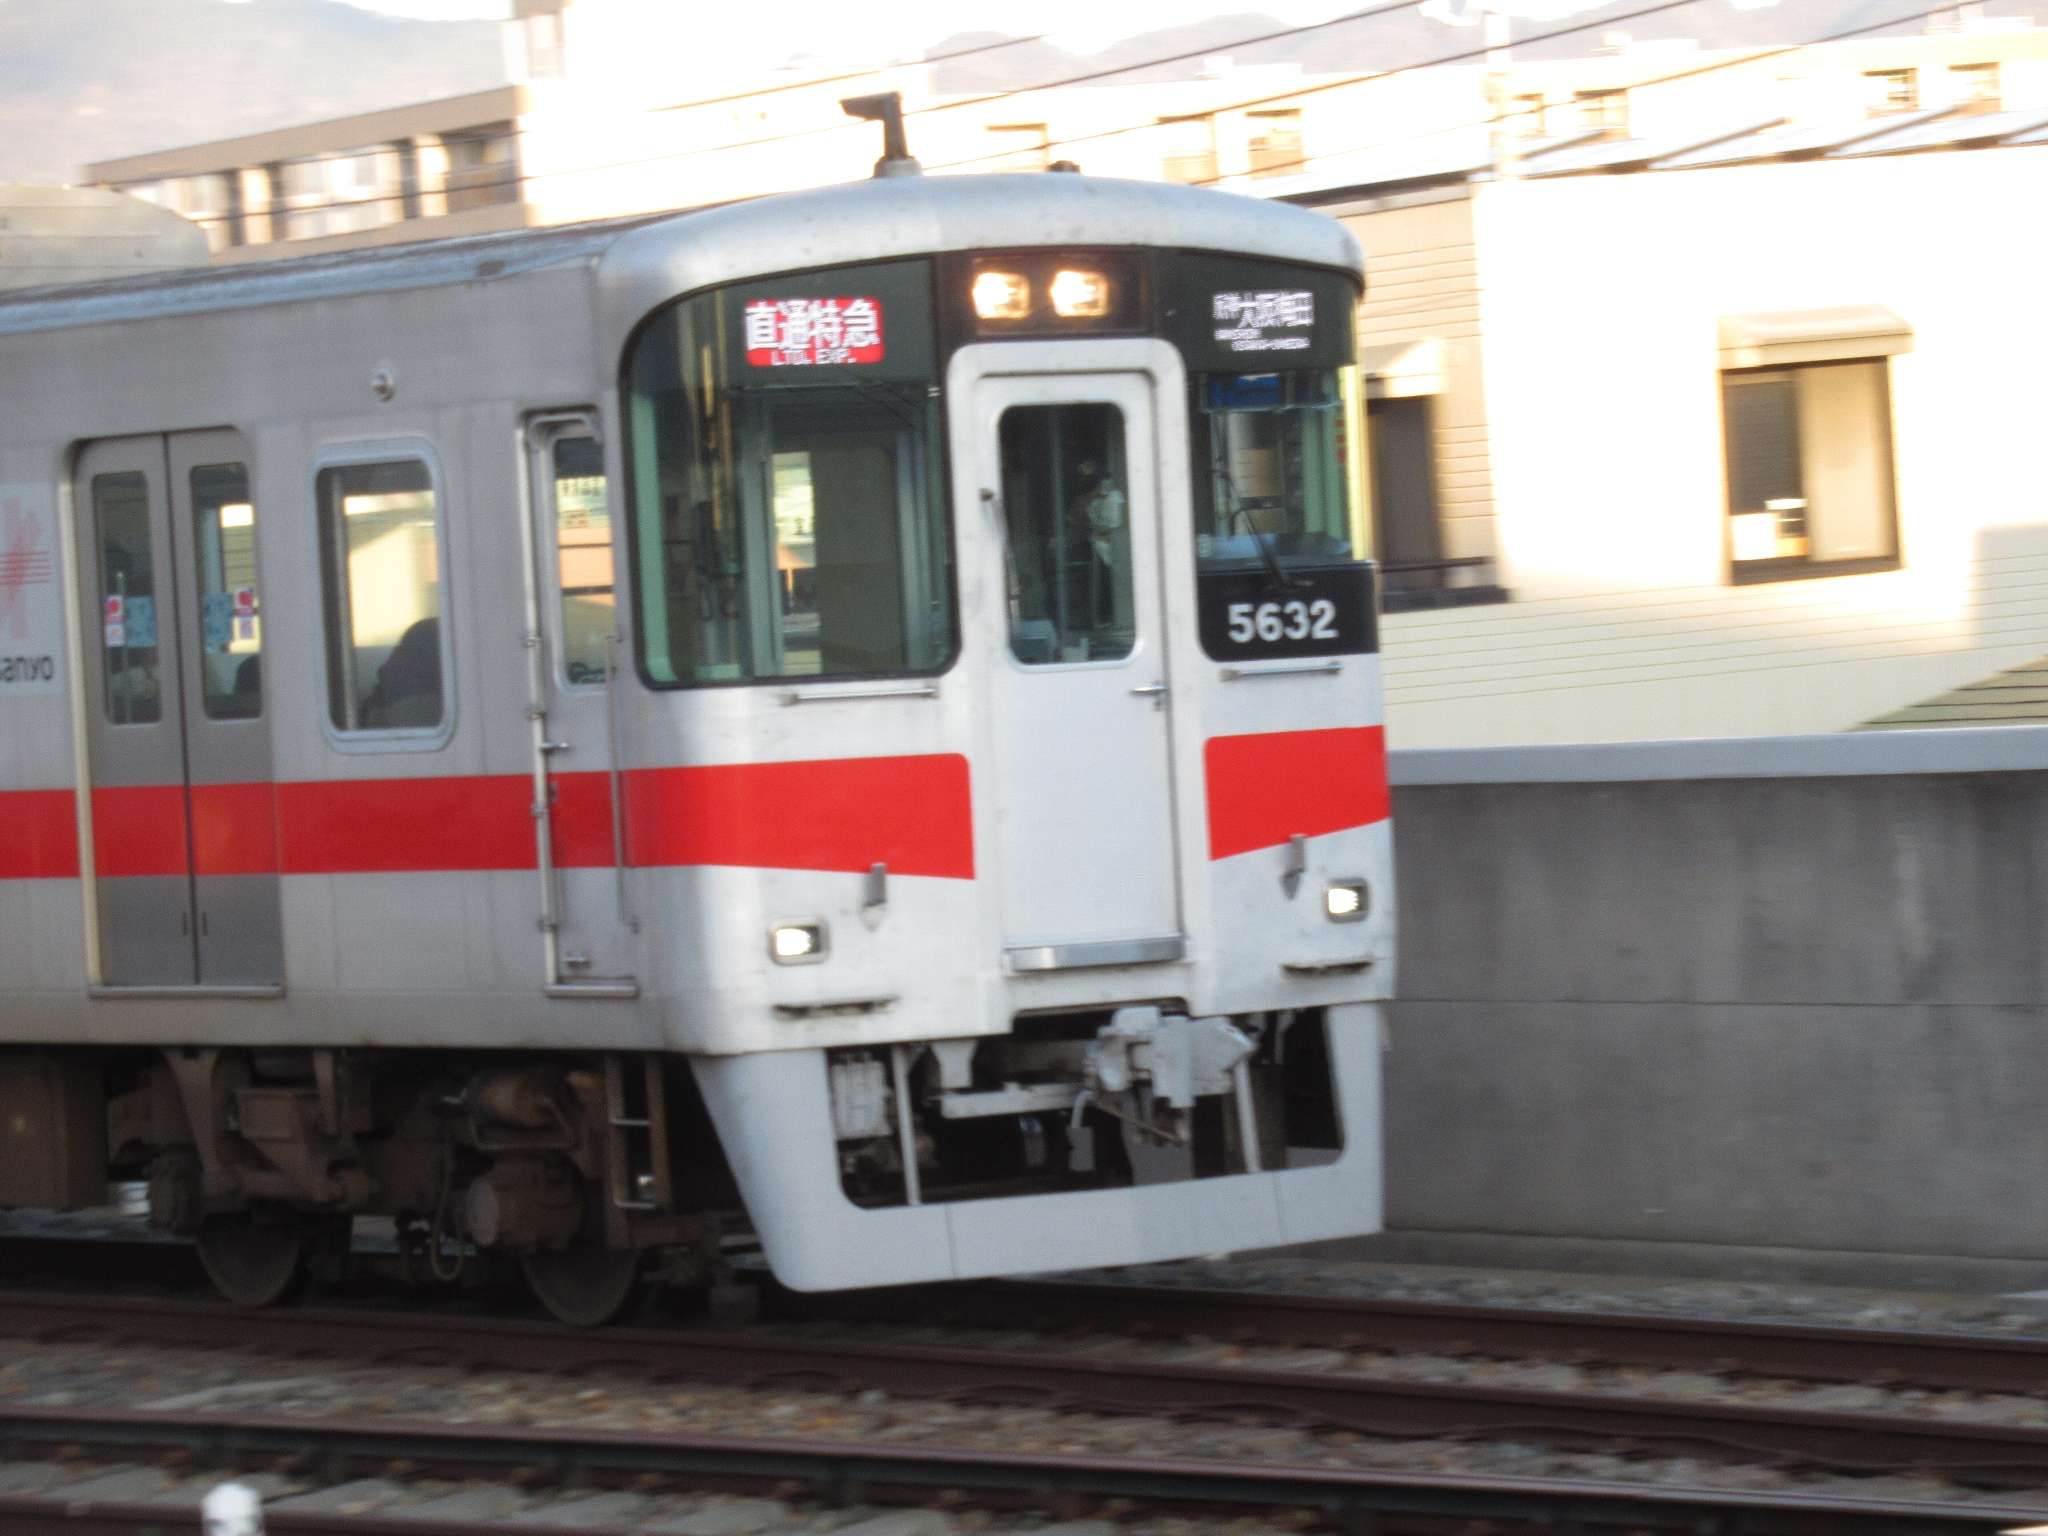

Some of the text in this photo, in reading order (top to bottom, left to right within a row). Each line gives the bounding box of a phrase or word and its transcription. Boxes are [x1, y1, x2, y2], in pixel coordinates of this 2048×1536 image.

[745, 299, 880, 350] 直通特急
[1228, 600, 1339, 643] 5632
[0, 657, 53, 682] anyo
